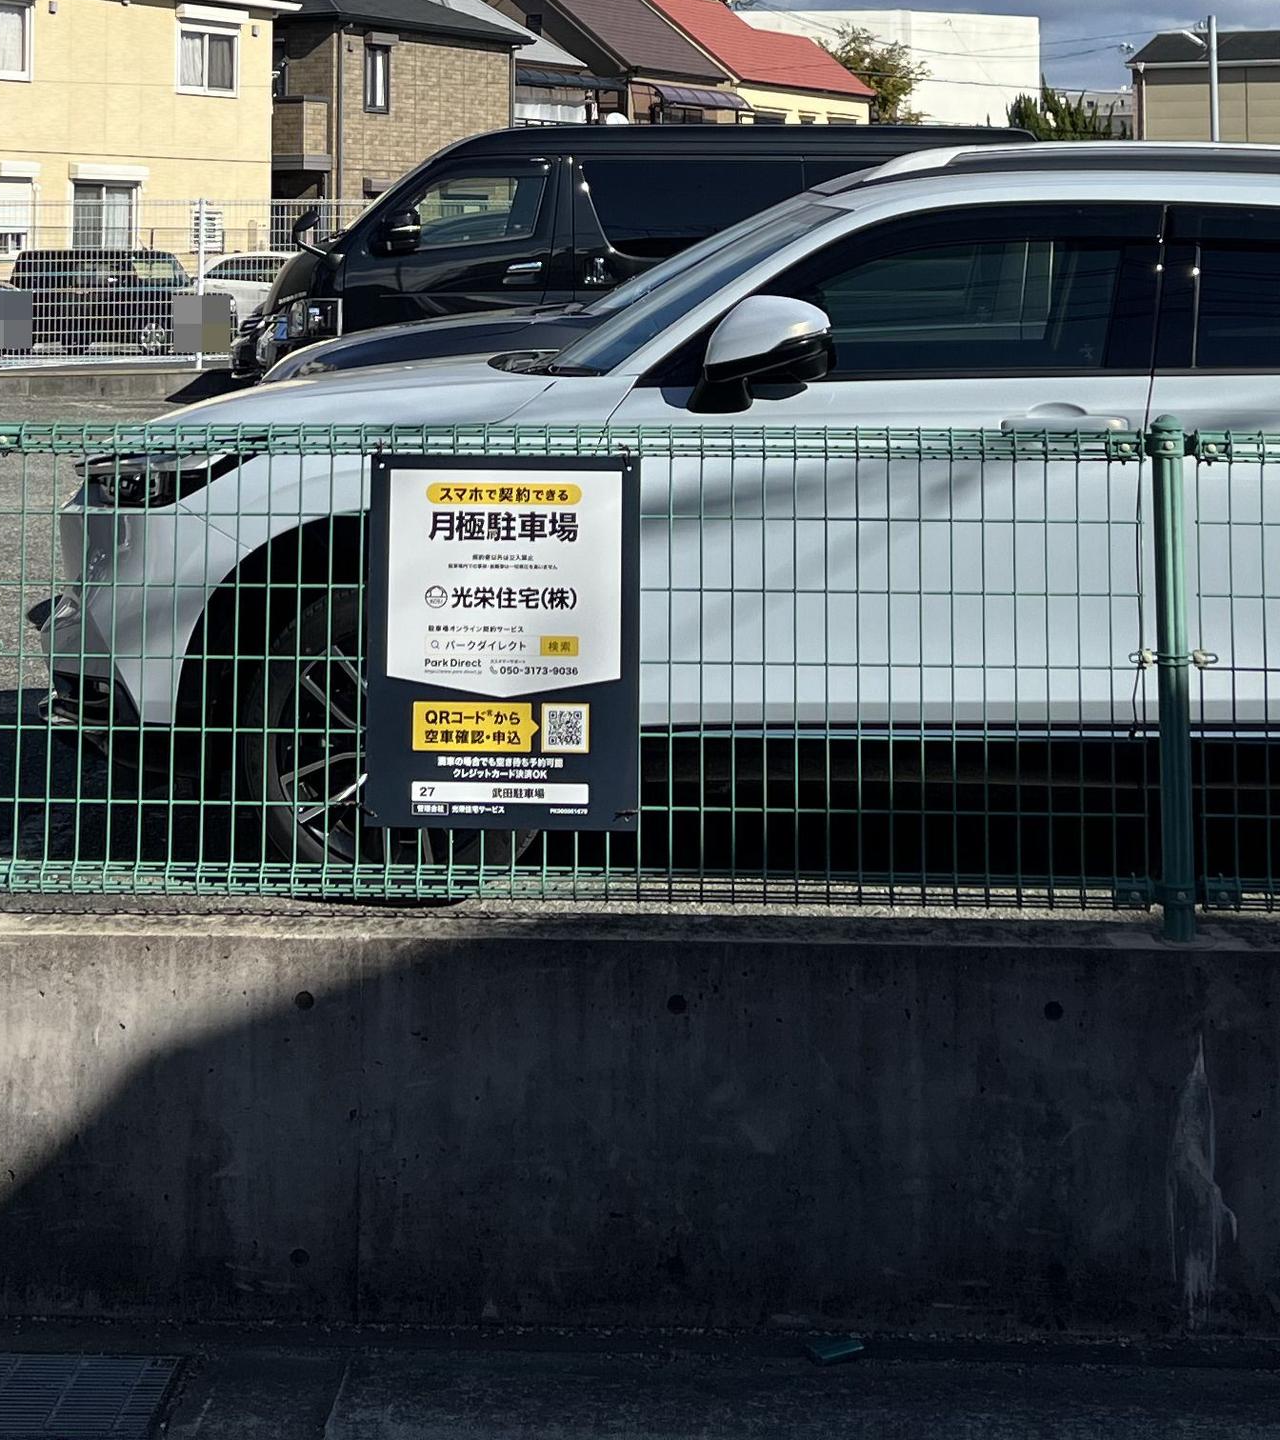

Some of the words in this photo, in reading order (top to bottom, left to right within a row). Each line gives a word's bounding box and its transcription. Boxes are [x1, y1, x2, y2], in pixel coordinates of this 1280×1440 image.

[439, 487, 569, 503] スマホで契約できる
[428, 510, 579, 542] 月極駐車場
[451, 586, 578, 610] 光栄住宅(株)
[445, 640, 527, 651] パークダイレクト
[548, 641, 571, 652] 検索
[424, 659, 448, 667] Park
[450, 659, 482, 668] Direct
[500, 666, 579, 676] 050-3173-9036
[424, 729, 521, 744] 空車確認・申込
[419, 787, 435, 797] 27
[491, 788, 545, 799] 武田駐車場
